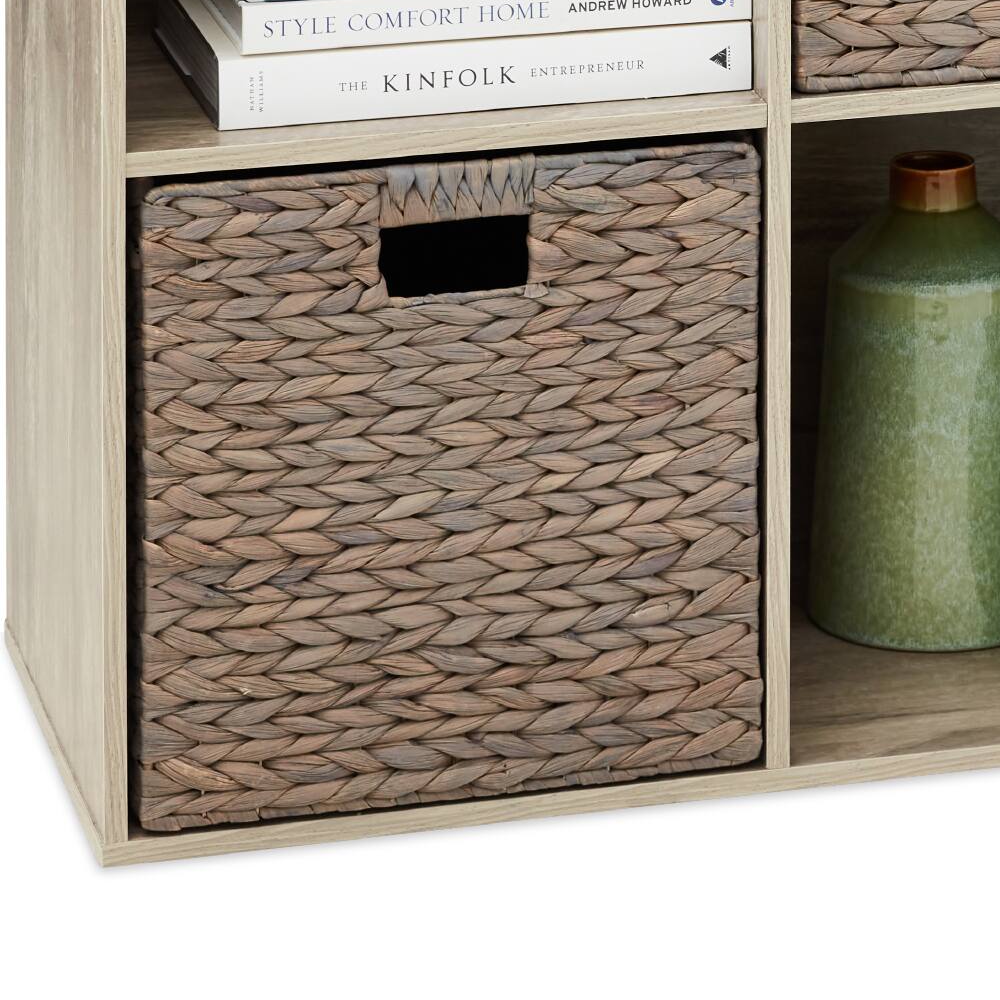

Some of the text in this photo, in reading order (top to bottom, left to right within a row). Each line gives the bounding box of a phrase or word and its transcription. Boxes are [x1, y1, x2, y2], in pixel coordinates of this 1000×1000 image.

[263, 1, 550, 39] STYLE COMFORT HOME
[568, 0, 628, 13] ANDREW
[338, 59, 646, 93] THE KINFOLK ENTREPRENEUR
